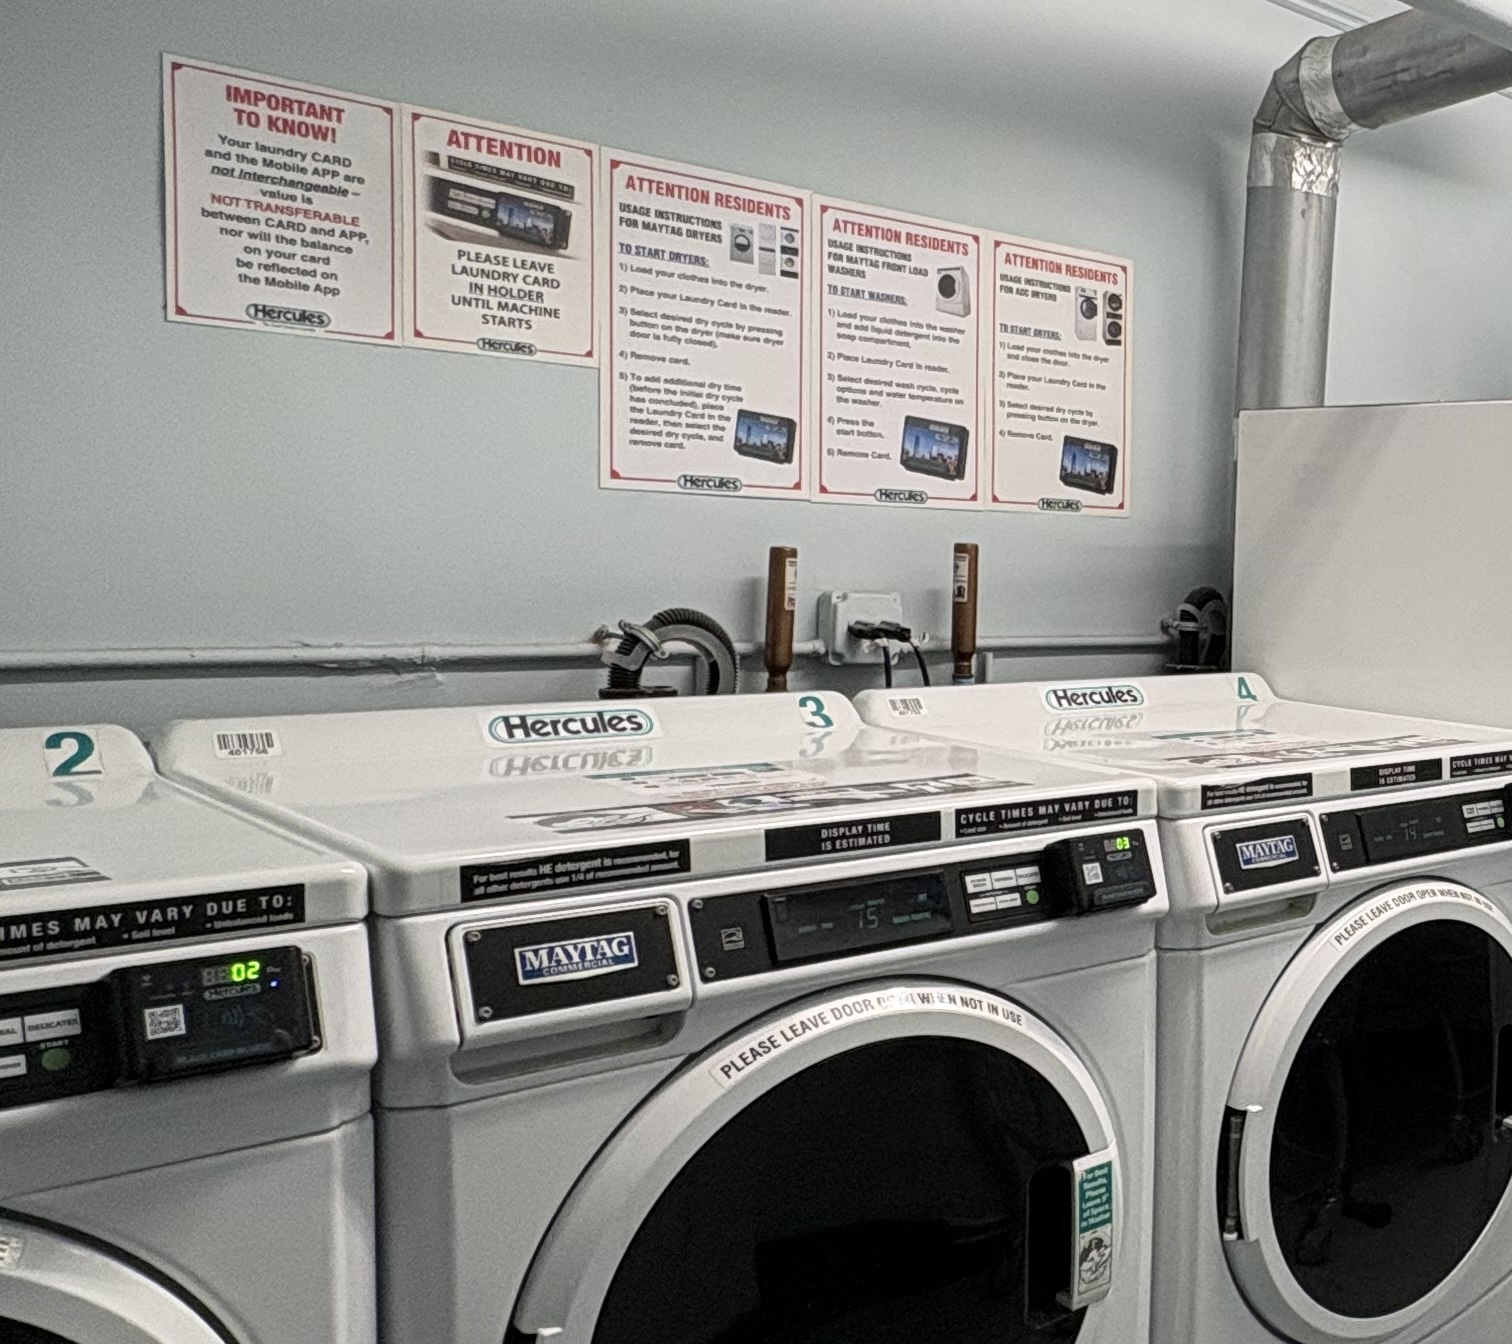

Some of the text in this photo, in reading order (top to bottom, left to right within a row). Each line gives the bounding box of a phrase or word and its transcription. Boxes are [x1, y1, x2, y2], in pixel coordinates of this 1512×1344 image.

[225, 84, 345, 124] IMPORTANT
[233, 107, 336, 143] TO KNOW!
[217, 133, 352, 168] Your laundry CARD
[446, 128, 560, 168] ATTENTION
[204, 149, 365, 185] and the Mobile APP are
[210, 165, 236, 178] not
[259, 188, 313, 205] value is
[625, 174, 790, 220] ATTENTION RESIDENTS
[210, 192, 360, 227] NOT TRANSFERABLE
[618, 202, 722, 230] USAGE INSTRUCTIONS
[200, 206, 369, 245] between CARD and APP,
[618, 216, 722, 243] FOR MAYTAG DRYERS
[832, 217, 968, 256] ATTENTION RESIDENTS
[219, 226, 353, 254] nor will the balance
[827, 238, 911, 262] USAGE INSTRUCTIONS
[243, 245, 330, 265] on your card
[457, 249, 554, 274] PLEASE LEAVE
[618, 242, 708, 267] TO START DRYERS:
[827, 251, 928, 277] FOR MAYTAG FRONT LOAD
[235, 257, 338, 281] be reflected on
[451, 263, 560, 289] LAUNDRY CARD
[827, 264, 865, 279] WASHERS
[1004, 252, 1118, 285] ATTENTION RESIDENTS
[237, 273, 340, 297] the Mobile App
[469, 281, 544, 303] IN HOLDER
[826, 283, 838, 295] TO
[840, 286, 865, 299] START
[252, 303, 325, 326] Hercules
[451, 294, 560, 319] UNTIL MACHINE
[481, 313, 532, 330] STARTS
[481, 337, 533, 354] Hercules
[682, 474, 738, 490] Hercules
[878, 488, 924, 503] Hercules
[1040, 498, 1079, 510] Hercules
[1051, 687, 1138, 708] Hercules
[1237, 677, 1258, 702] 4
[798, 696, 834, 728] 3
[501, 710, 643, 742] Hercules
[44, 731, 103, 778] 2
[960, 810, 996, 825] CYCLE
[1001, 807, 1034, 820] TIMES
[1038, 804, 1060, 815] MAY
[1064, 801, 1090, 812] VARY
[1094, 798, 1113, 809] DUE
[820, 821, 891, 840] DISPLAY TIME
[821, 834, 891, 851] IS ESTIMATED
[1116, 836, 1130, 850] 03
[1241, 839, 1294, 860] MAYTAG
[539, 857, 612, 876] HE detergent is
[74, 912, 125, 932] MAY
[135, 904, 195, 925] VARY
[206, 898, 248, 916] DUE
[259, 894, 293, 910] TO:
[1334, 888, 1438, 946] PLEASE LEAVE DOOR OPEN
[523, 937, 630, 971] MAYTAG
[231, 961, 261, 982] 02
[542, 959, 615, 977] COMMERCIAL
[719, 1034, 782, 1080] PLEASE
[780, 1011, 831, 1043] LEAVE
[832, 998, 875, 1022] DOOR
[959, 995, 985, 1012] NOT
[987, 1002, 1000, 1015] IN
[1001, 1009, 1024, 1027] USE
